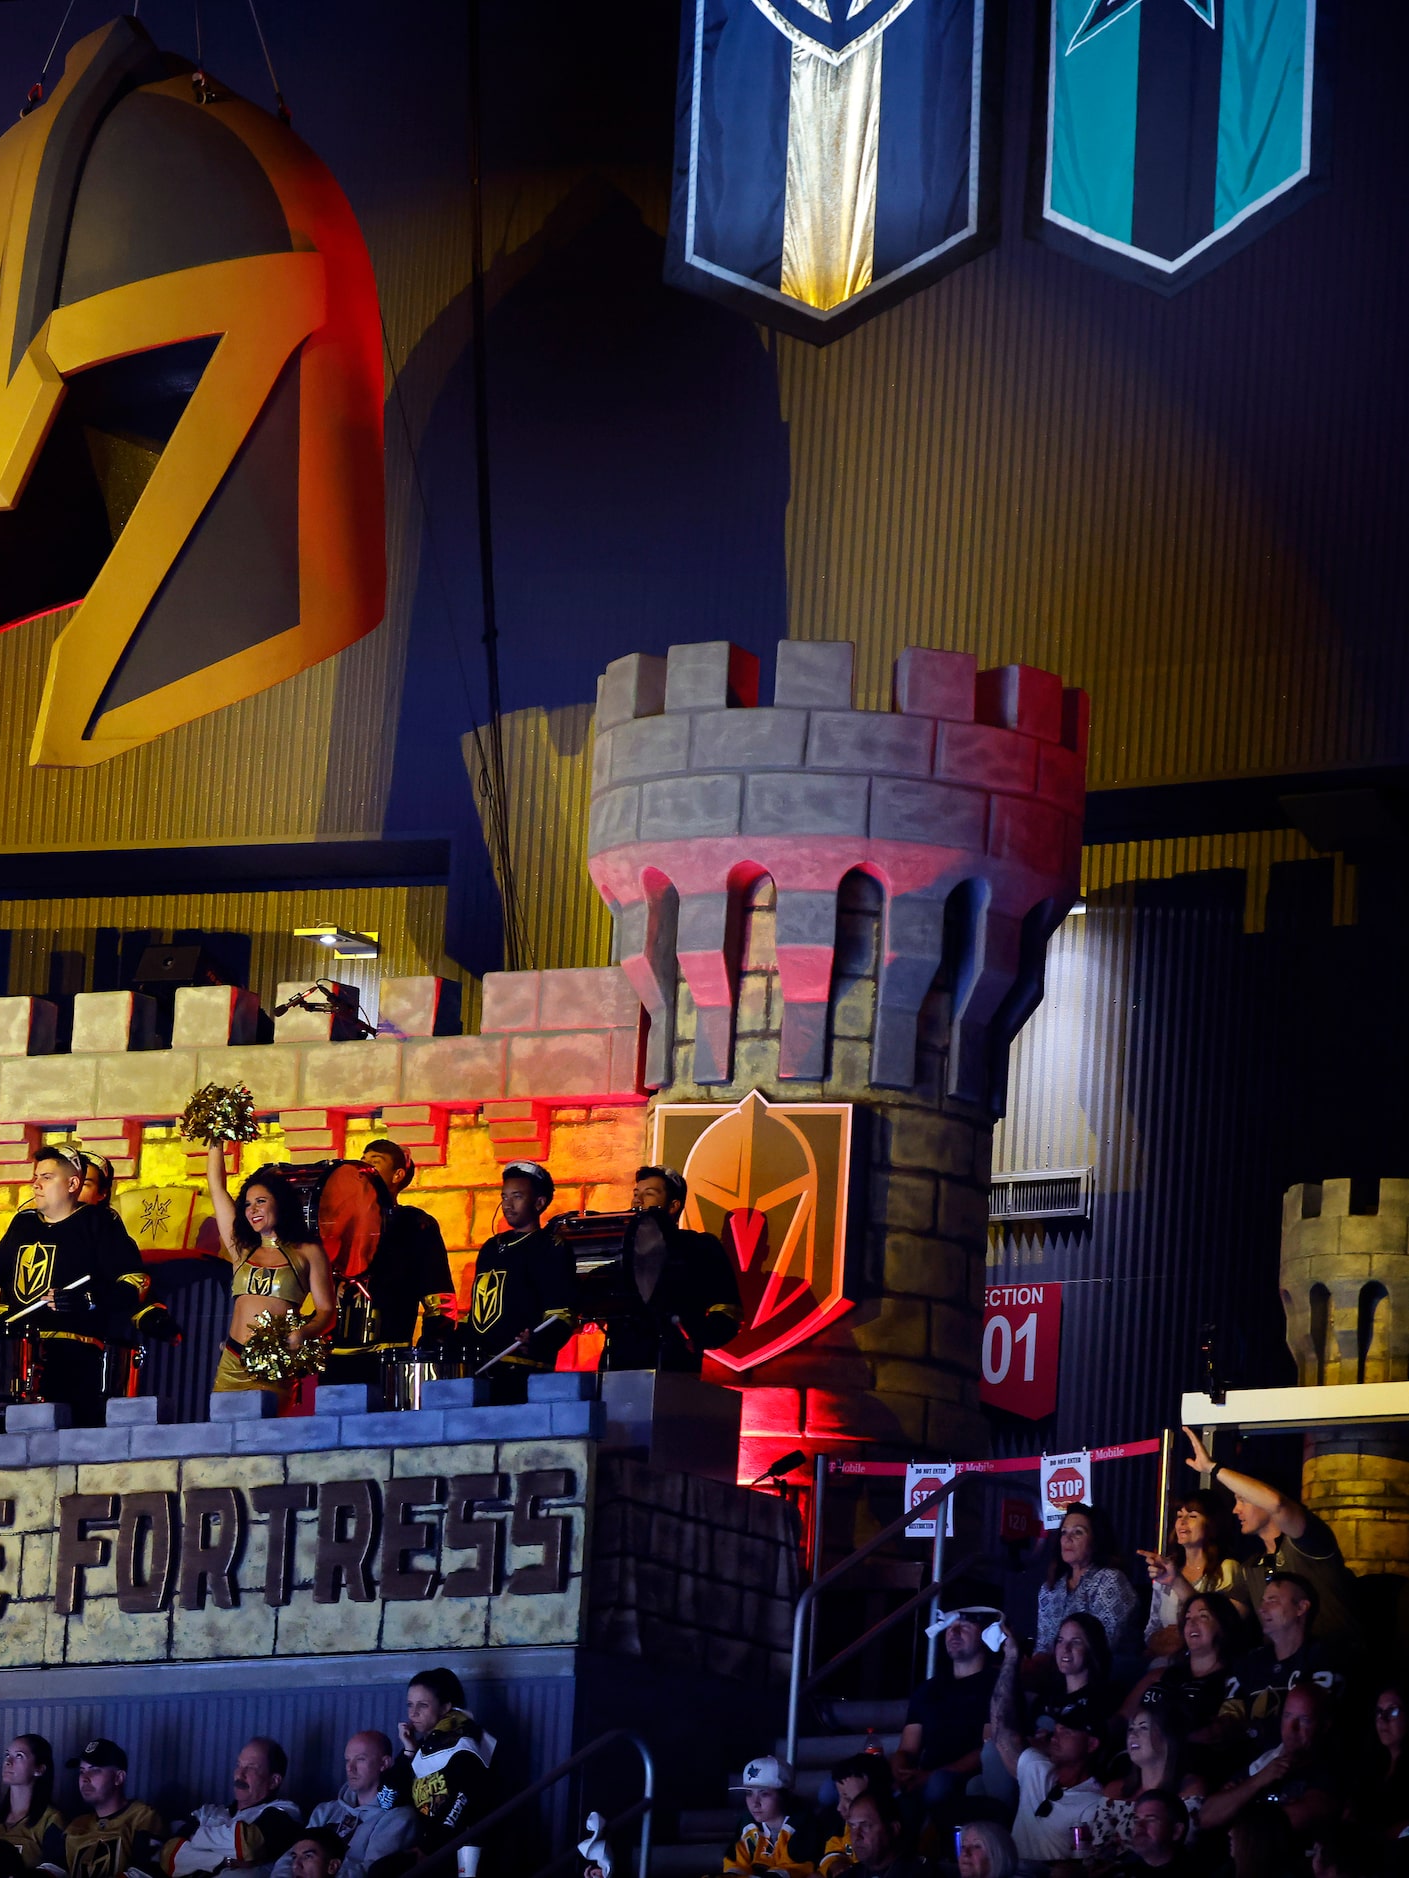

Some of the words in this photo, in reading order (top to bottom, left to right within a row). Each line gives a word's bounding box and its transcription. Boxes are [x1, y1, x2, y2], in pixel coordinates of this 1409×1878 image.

[985, 1287, 1044, 1307] CTION
[982, 1313, 1038, 1385] 01
[912, 1490, 936, 1506] ST
[1049, 1479, 1083, 1498] STOP
[53, 1468, 577, 1615] FORTRESS
